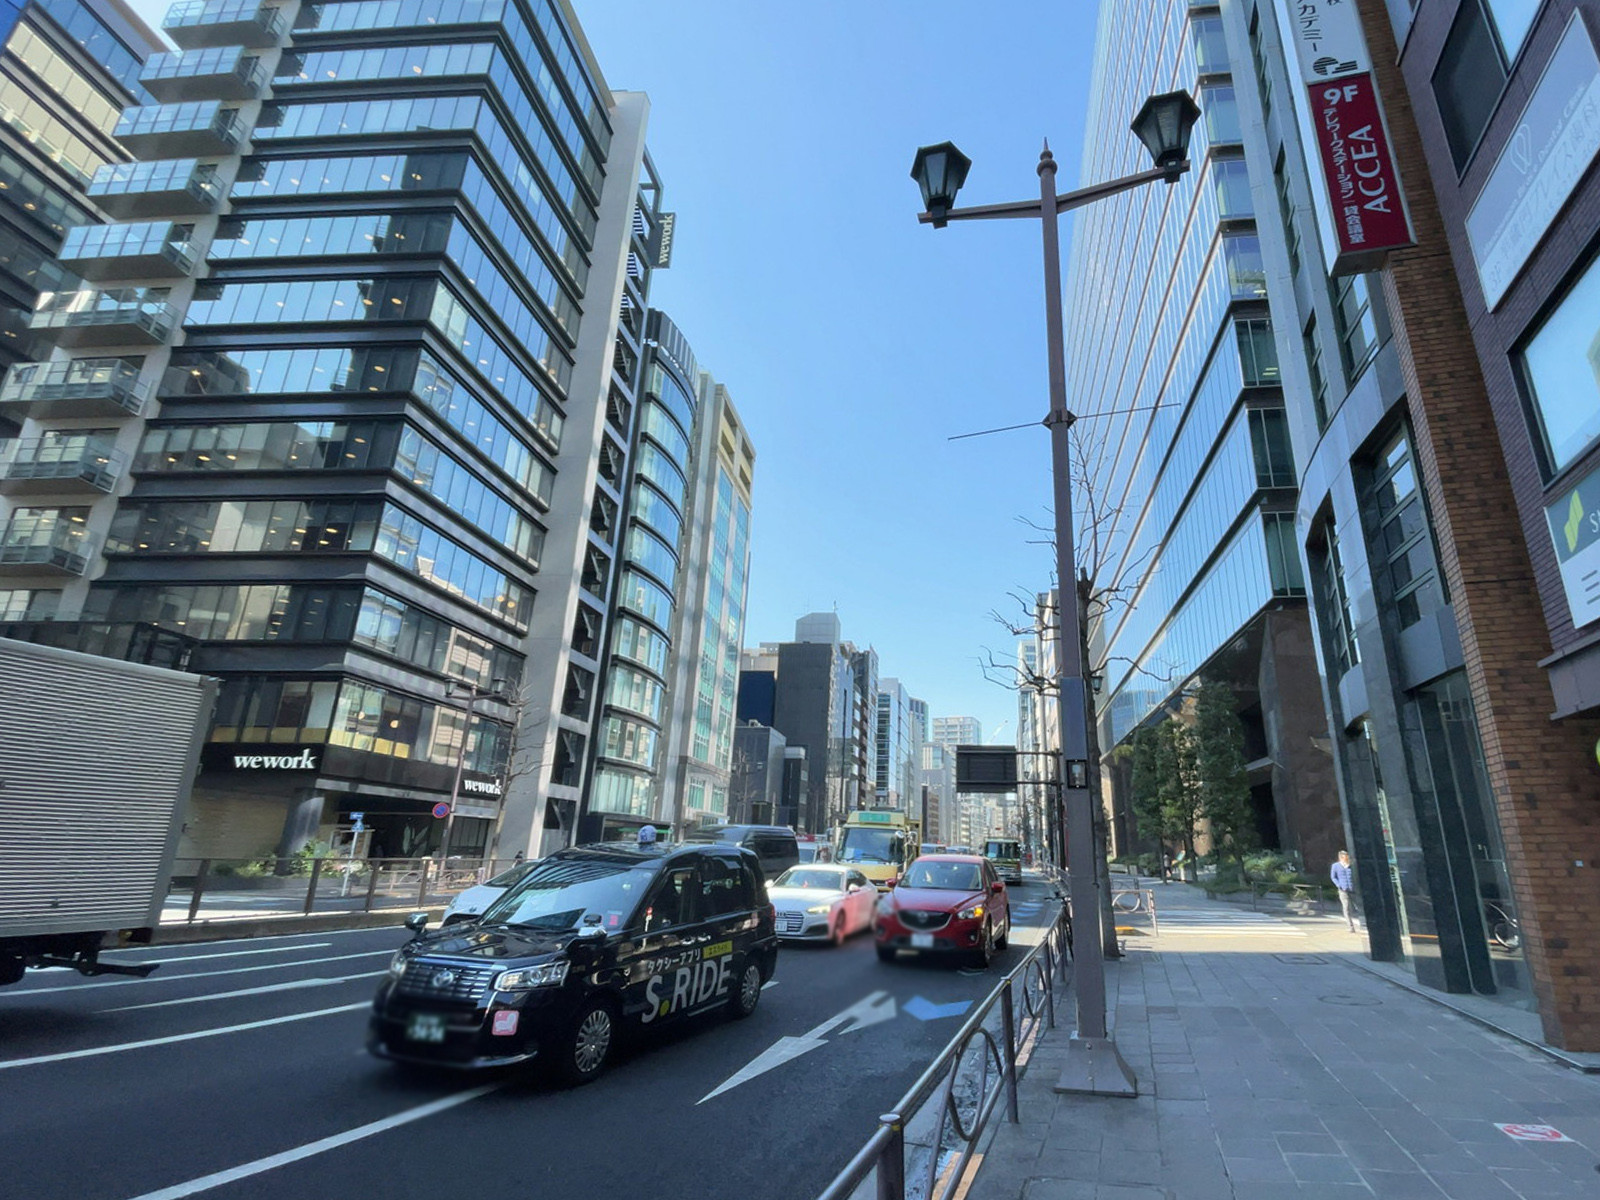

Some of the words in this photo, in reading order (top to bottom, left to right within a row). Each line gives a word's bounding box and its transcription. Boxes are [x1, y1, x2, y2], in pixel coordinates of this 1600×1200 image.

[1323, 85, 1358, 105] 9F
[1323, 107, 1355, 198] テレワークステーション
[1348, 124, 1391, 213] ACCEA
[658, 214, 674, 264] wework
[234, 748, 317, 769] wework
[464, 779, 502, 795] wework
[647, 948, 701, 974] タクシーアプリ
